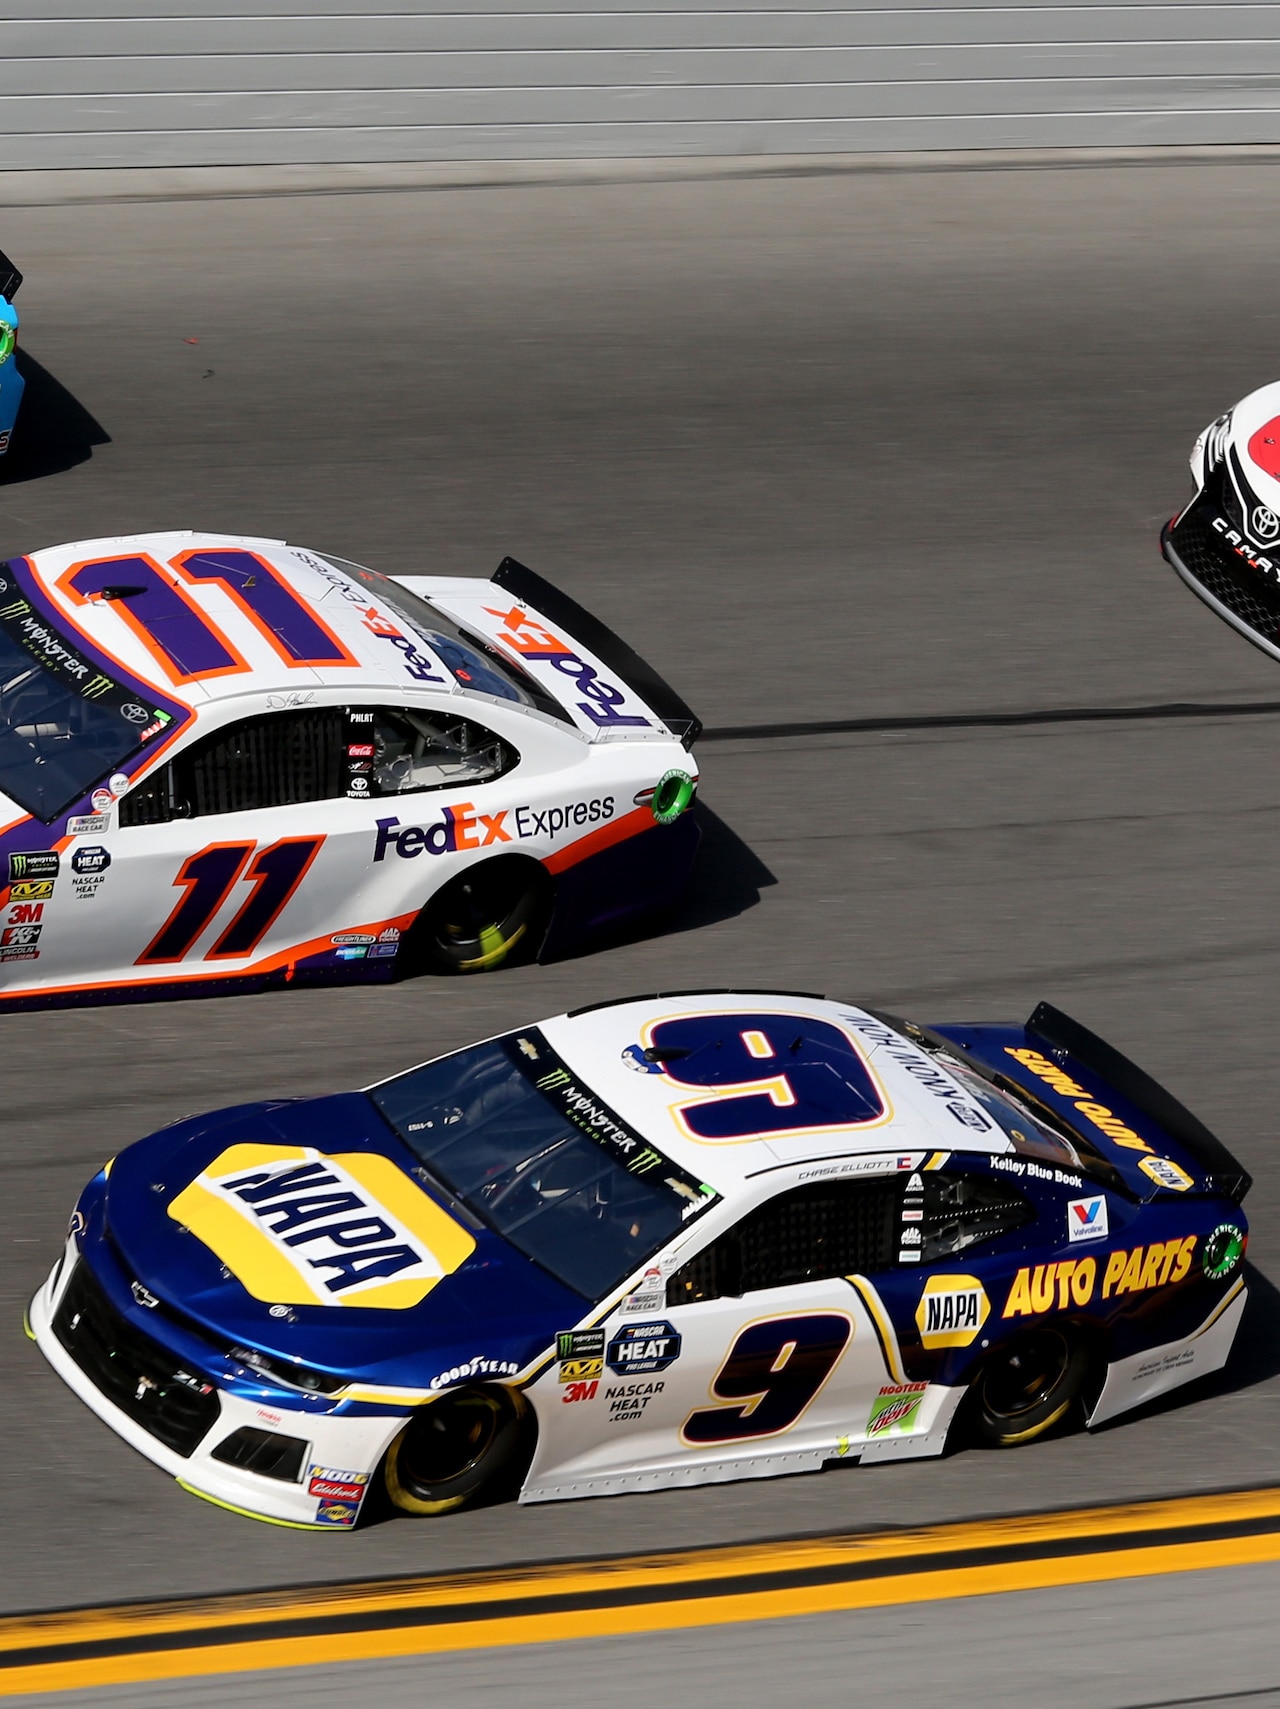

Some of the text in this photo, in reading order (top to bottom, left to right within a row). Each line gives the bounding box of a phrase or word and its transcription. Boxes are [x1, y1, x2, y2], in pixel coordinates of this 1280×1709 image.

[289, 551, 367, 603] Express
[54, 548, 361, 688] 11
[353, 604, 446, 683] FedEx
[481, 606, 652, 728] FedEx
[346, 790, 370, 798] TOYOTA
[72, 823, 103, 833] RACE CAR
[372, 795, 615, 863] FedEx Express
[77, 855, 106, 868] HEAT
[72, 876, 105, 886] NASCAR
[76, 885, 99, 894] HEAT
[132, 834, 328, 966] 11
[8, 903, 44, 925] 3M
[0, 946, 35, 957] LINCOLN
[837, 1013, 908, 1049] HOW
[885, 1050, 966, 1100] KNOW
[1003, 1046, 1095, 1100] PARTS
[1073, 1101, 1156, 1154] AUTO
[798, 1160, 894, 1180] CHASE ELLIOTT
[990, 1155, 1083, 1188] Kelley Blue Book
[1148, 1160, 1186, 1186] NAPA
[220, 1161, 424, 1293] NAPA
[1073, 1225, 1104, 1237] Valvoline
[1205, 1224, 1243, 1252] AMERICAN
[1002, 1235, 1198, 1320] AUTO PARTS
[1204, 1255, 1240, 1280] ETHANOL
[926, 1292, 978, 1333] NAPA
[634, 1325, 665, 1338] NASCAR
[618, 1339, 670, 1361] HEAT
[430, 1355, 519, 1390] GOODYEAR
[677, 1308, 857, 1448] 9
[562, 1380, 599, 1403] 3M
[605, 1382, 665, 1399] NASCAR
[878, 1382, 928, 1396] HOOTERS
[609, 1397, 651, 1412] HEAT
[609, 1411, 642, 1422] .com
[310, 1466, 369, 1484] MOOG
